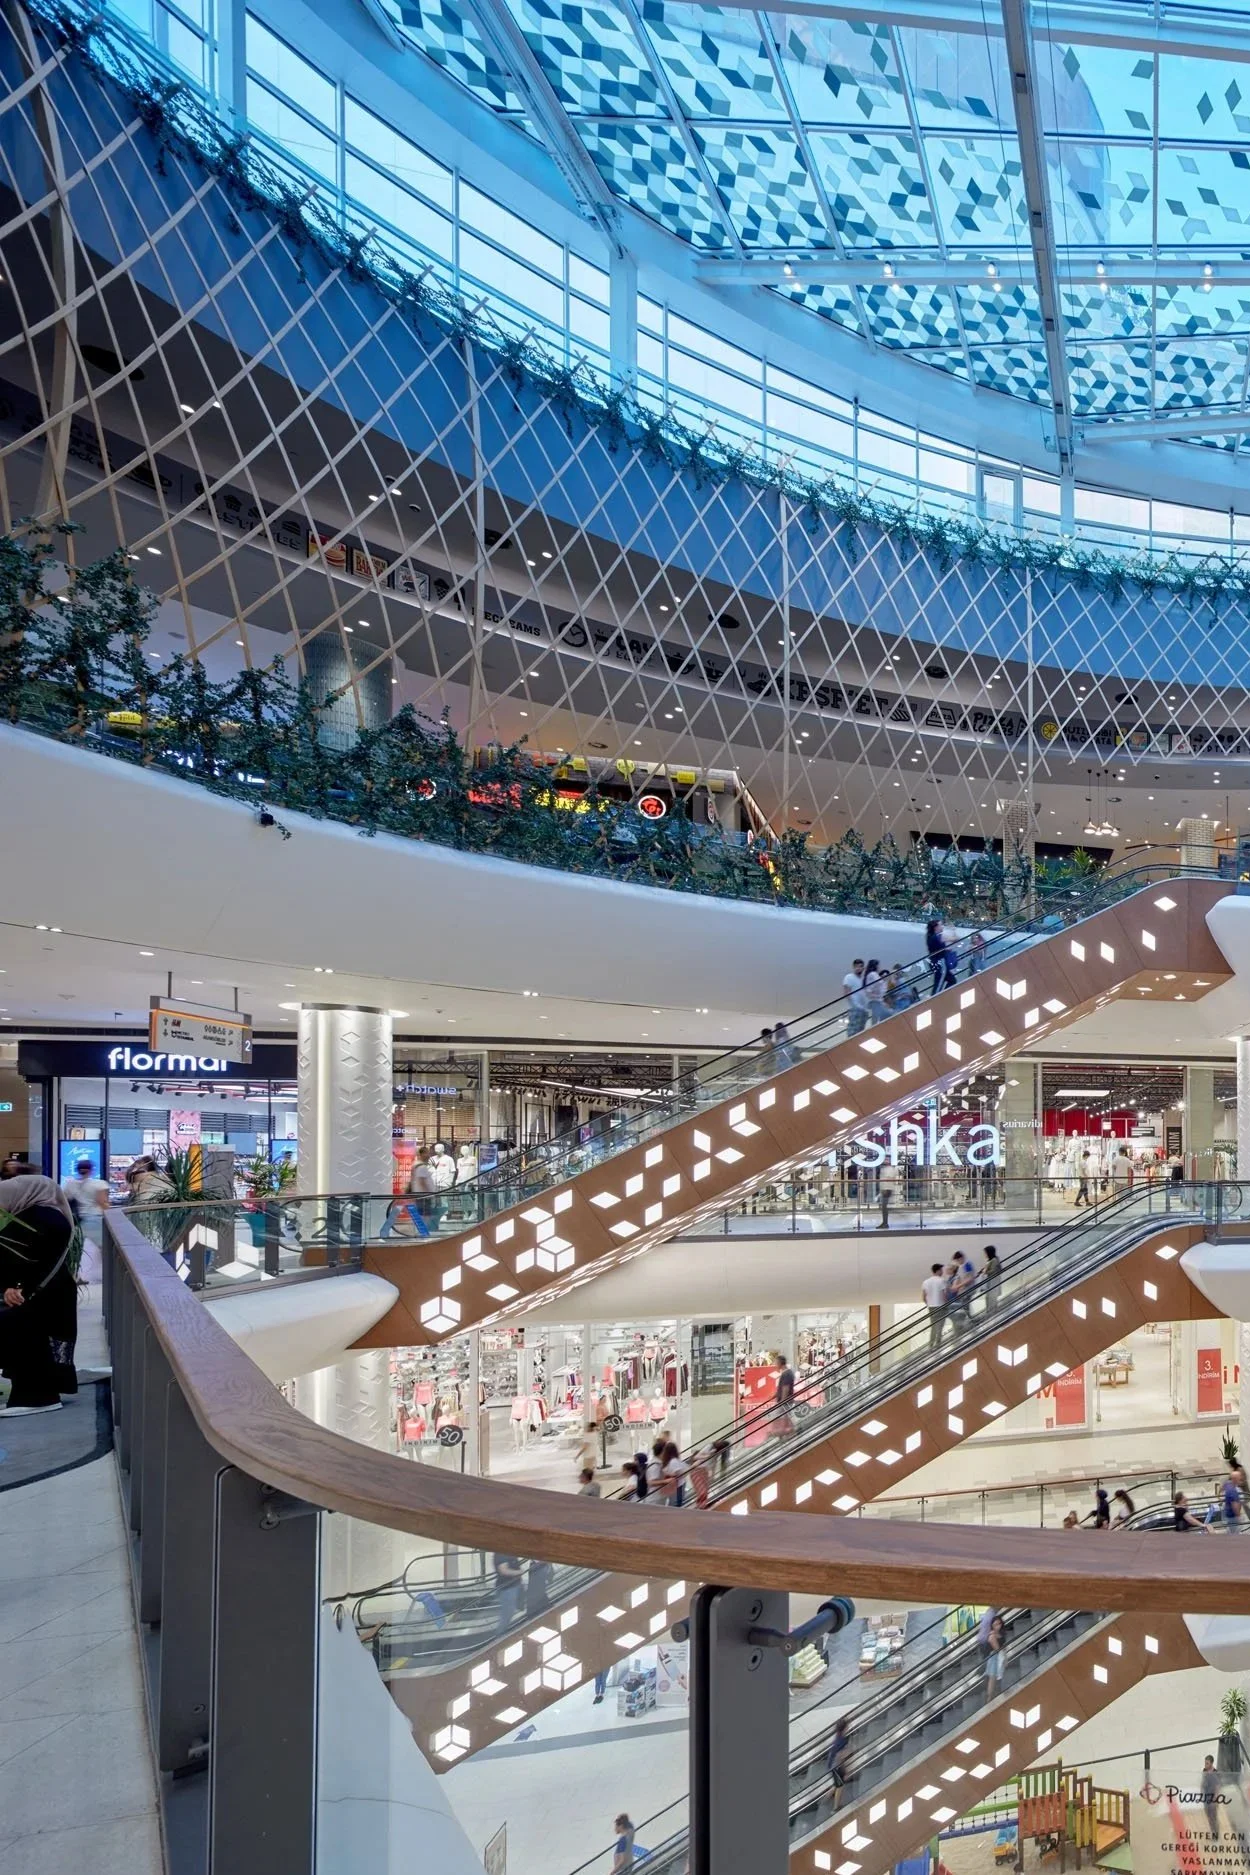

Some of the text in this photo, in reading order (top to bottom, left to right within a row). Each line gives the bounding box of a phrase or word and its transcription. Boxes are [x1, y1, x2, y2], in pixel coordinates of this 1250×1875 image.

[245, 1040, 251, 1051] 2
[605, 1416, 620, 1430] 50
[440, 1429, 460, 1444] 50
[1165, 1785, 1232, 1805] Piazza
[1179, 1831, 1219, 1841] LÜTFEN
[1223, 1832, 1245, 1842] CAN
[1161, 1842, 1199, 1852] GEREĞİ
